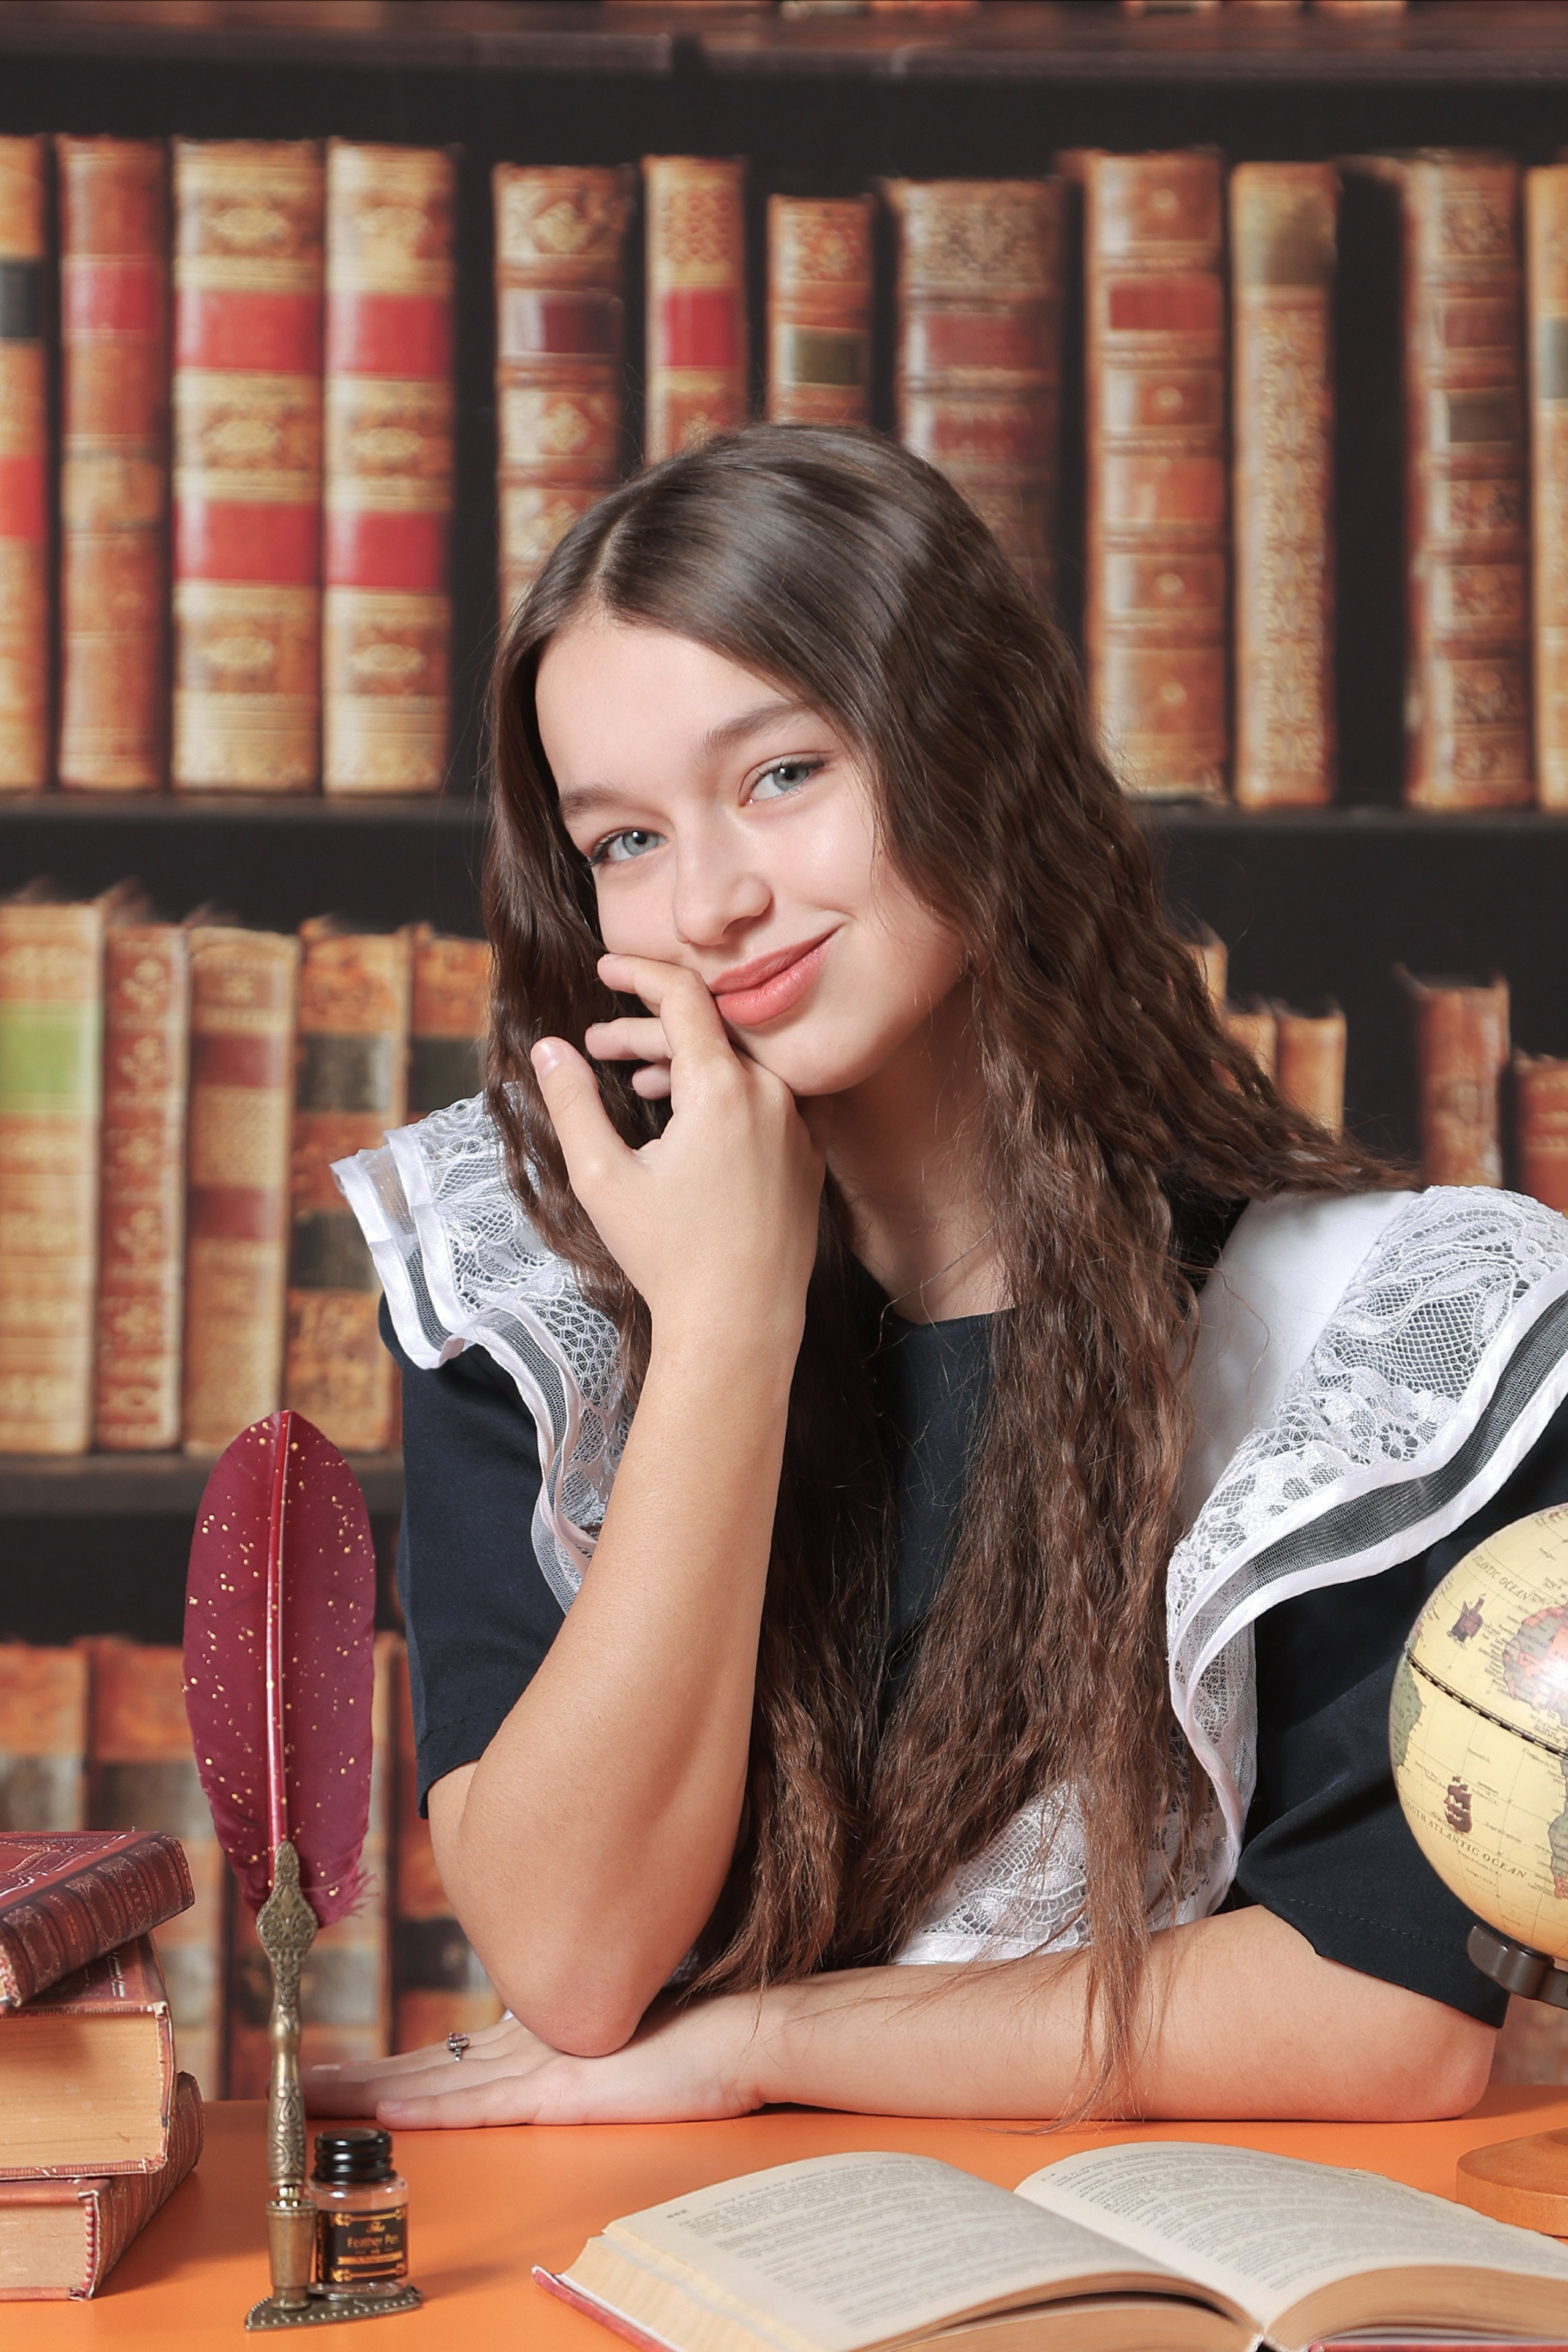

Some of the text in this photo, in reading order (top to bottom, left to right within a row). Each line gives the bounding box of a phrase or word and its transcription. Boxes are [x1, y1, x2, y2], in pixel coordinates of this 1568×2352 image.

[1499, 1577, 1531, 1600] OCEAN
[1405, 1798, 1427, 1822] SOUTH
[1428, 1820, 1480, 1856] ATLANTIC
[1483, 1853, 1527, 1879] OCEAN
